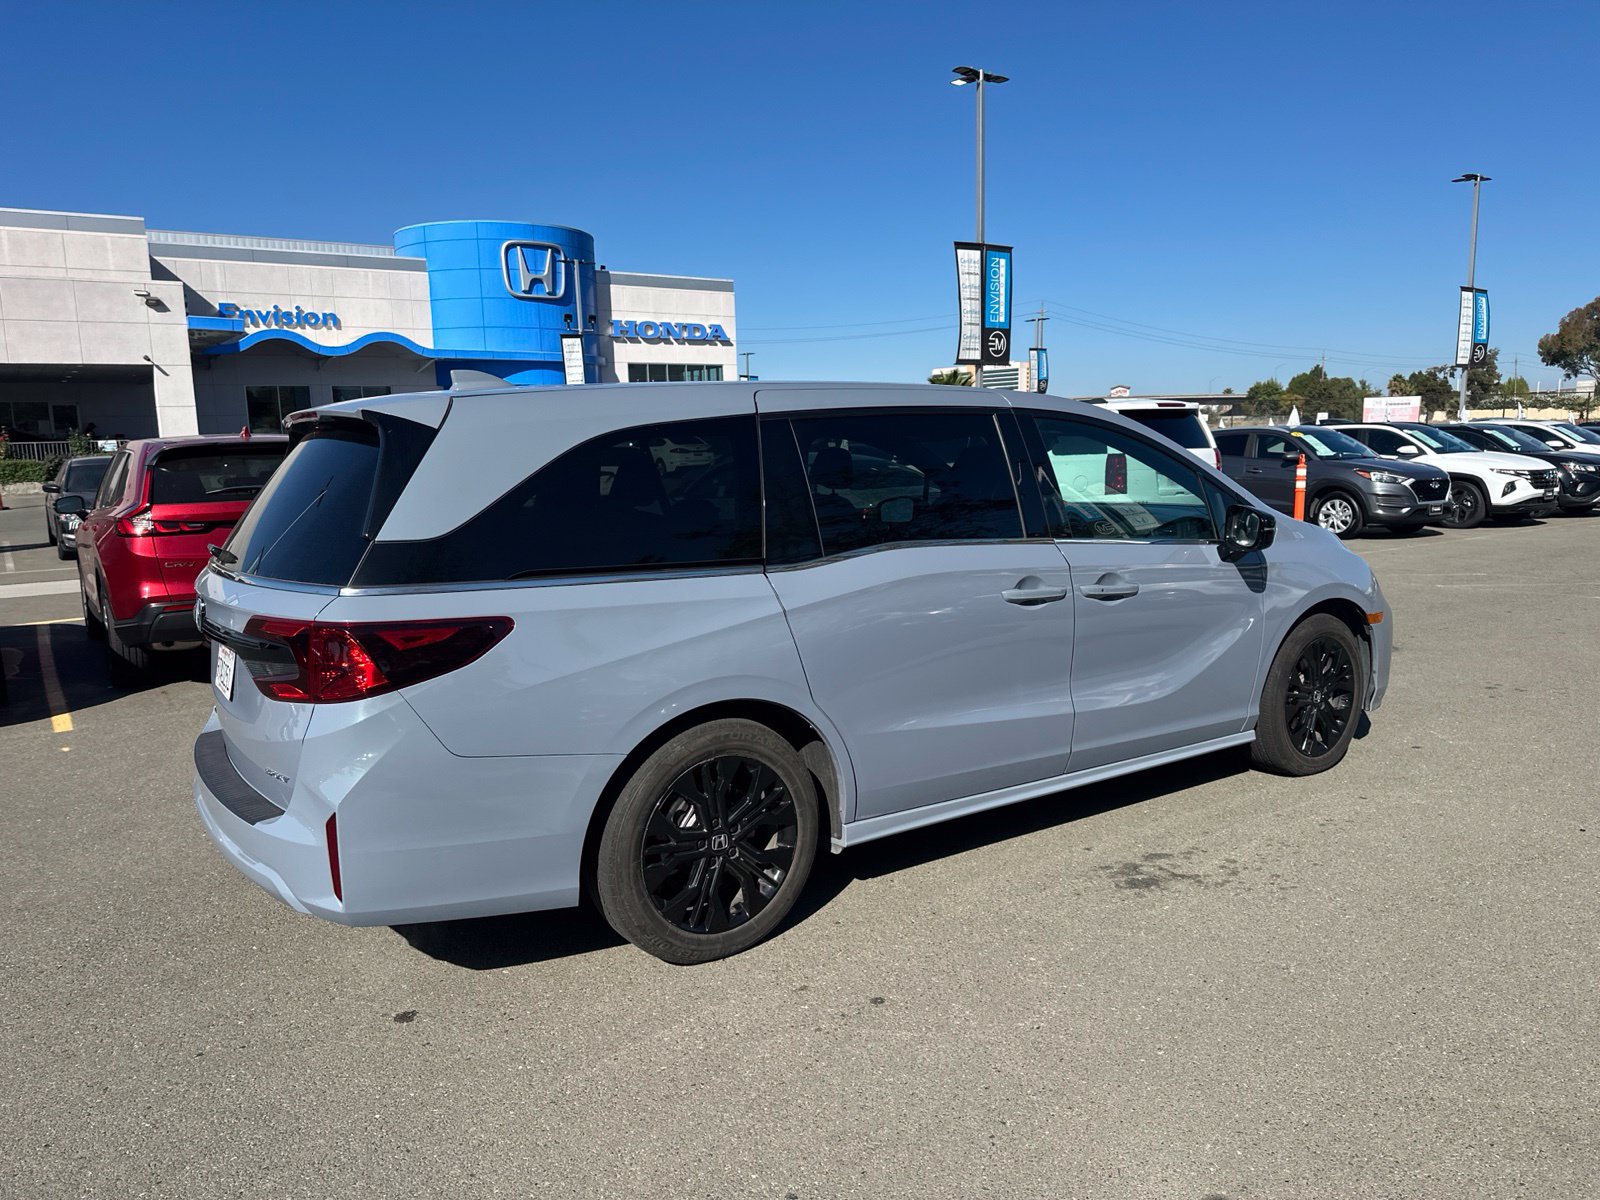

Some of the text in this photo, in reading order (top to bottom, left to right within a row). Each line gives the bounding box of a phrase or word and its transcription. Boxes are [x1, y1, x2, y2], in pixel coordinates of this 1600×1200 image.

[990, 257, 1000, 322] ENVISION
[218, 302, 338, 327] Envision
[610, 319, 732, 341] HONDA
